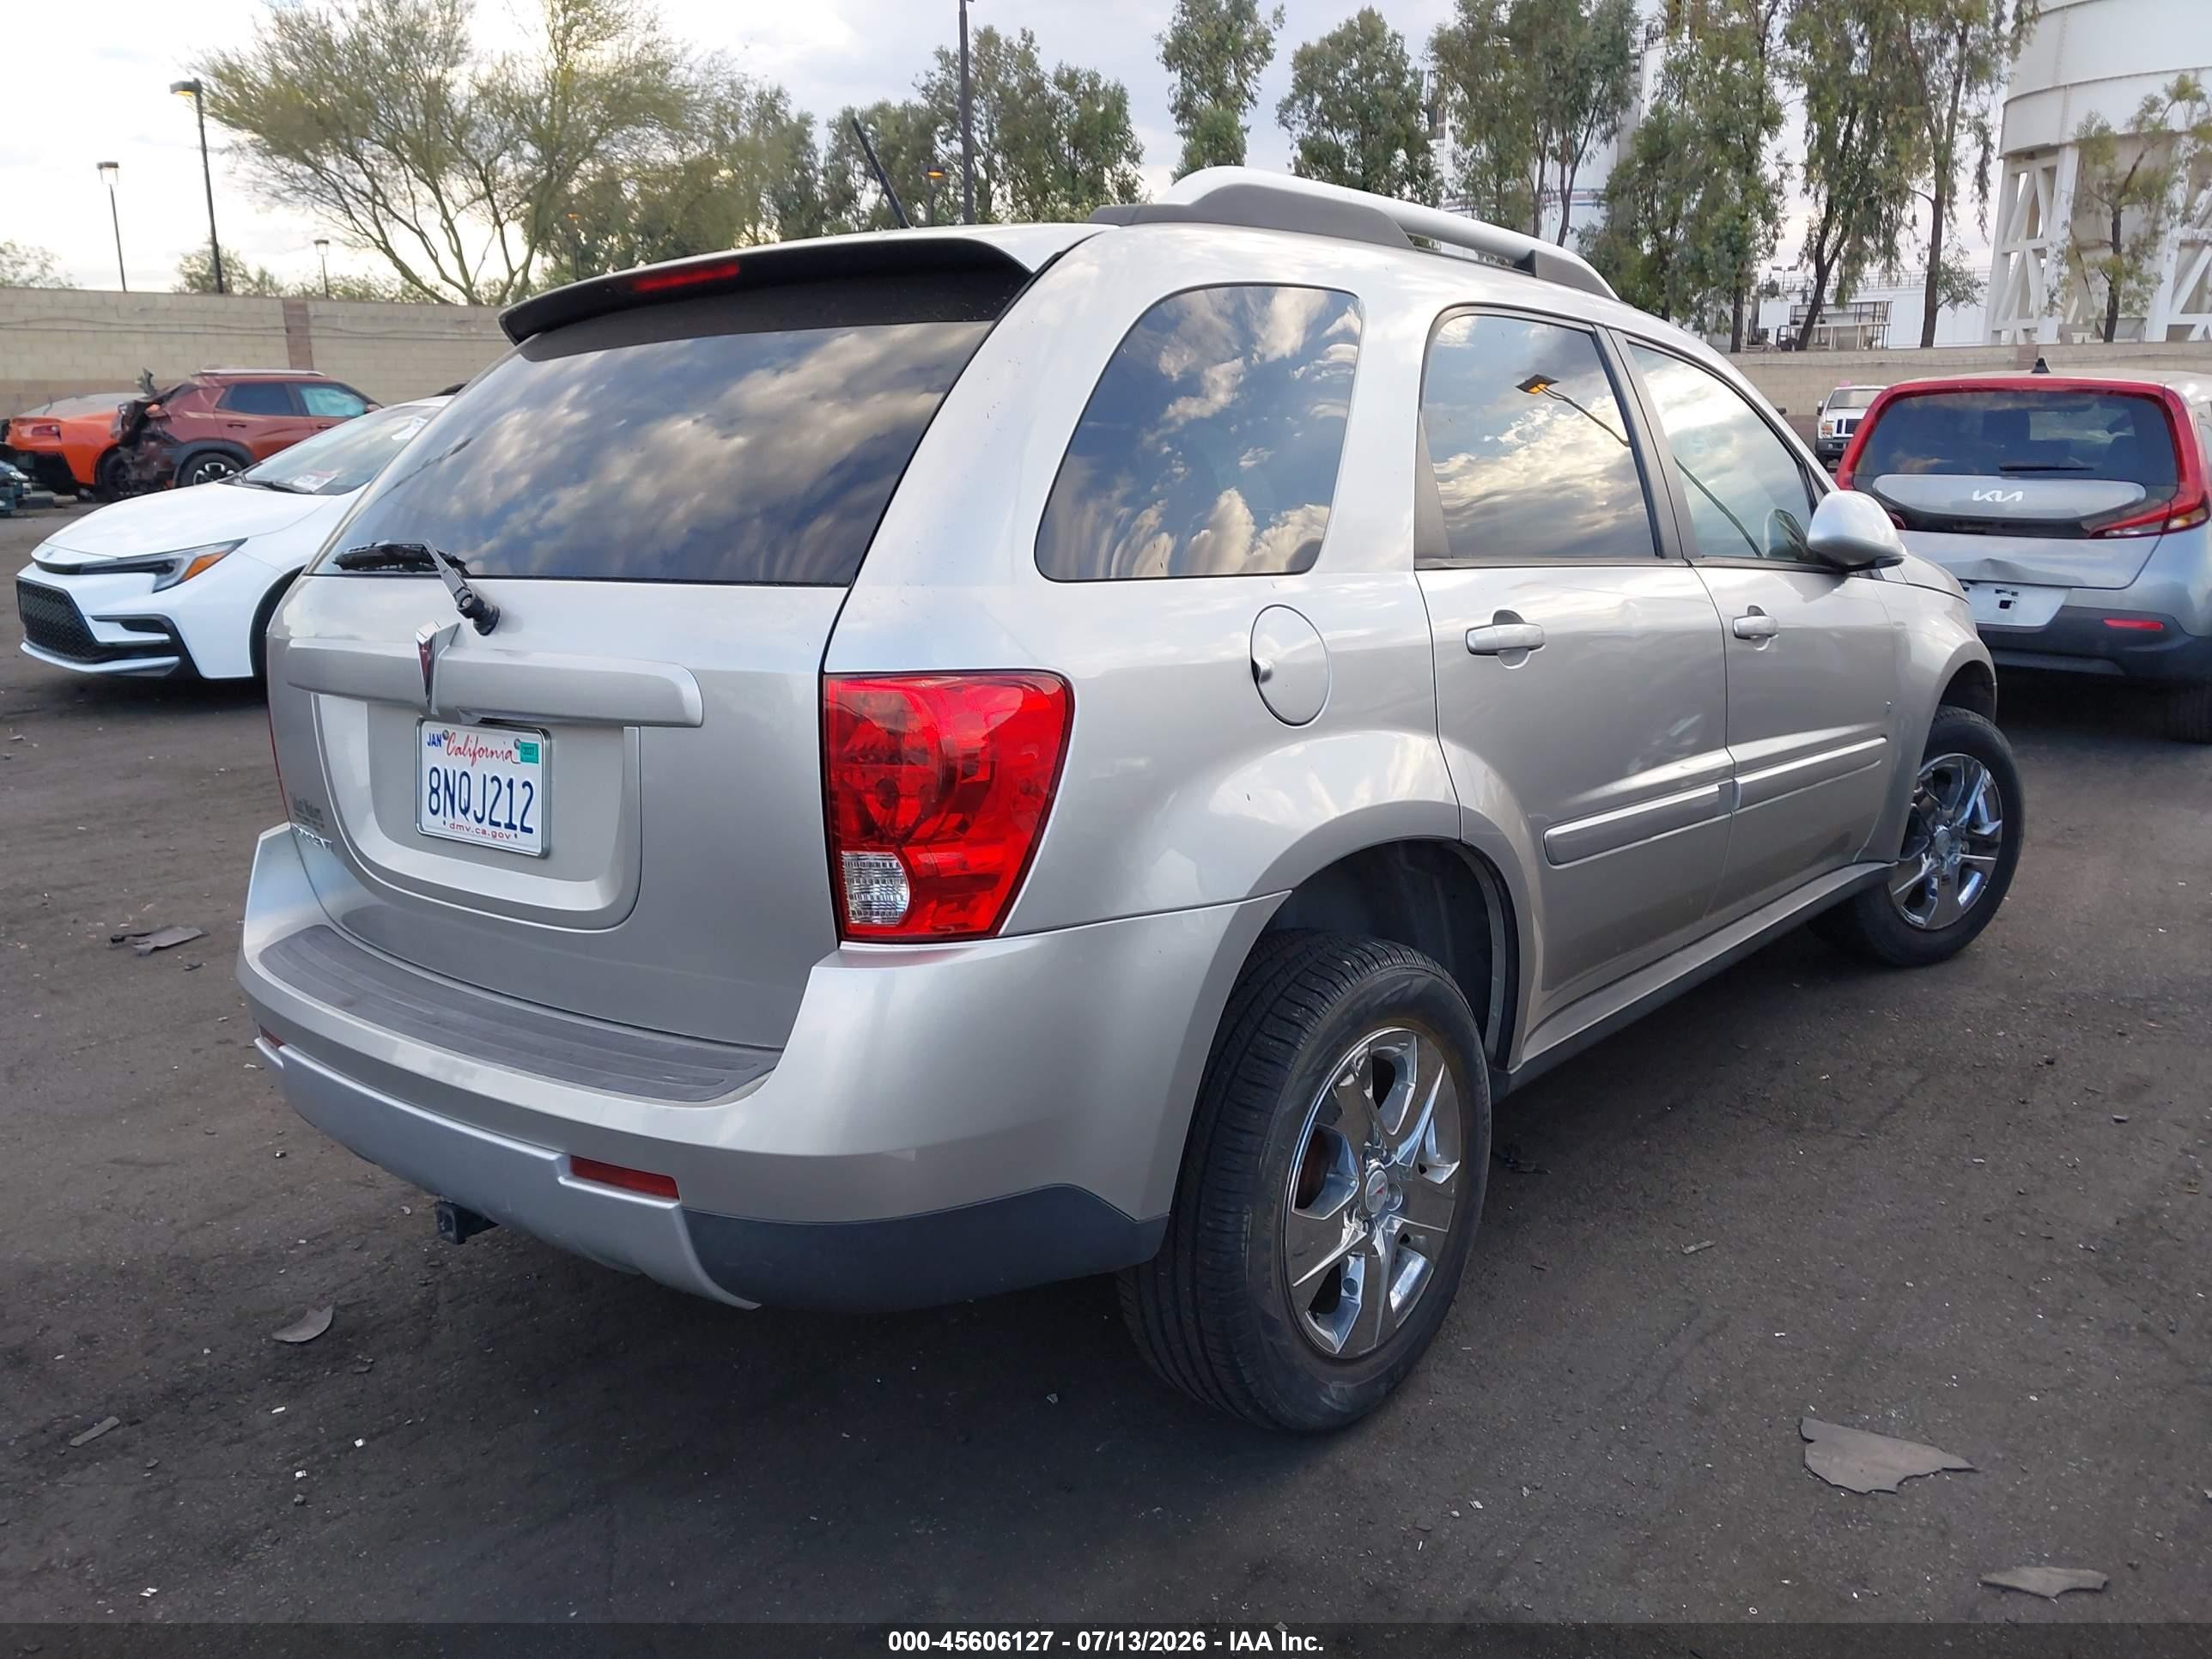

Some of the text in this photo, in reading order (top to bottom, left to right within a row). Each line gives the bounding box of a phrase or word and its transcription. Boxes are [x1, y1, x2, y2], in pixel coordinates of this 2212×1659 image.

[1972, 489, 2023, 502] KIA
[427, 732, 442, 748] JAN
[447, 732, 521, 767] California
[428, 766, 534, 835] 8NQJ212
[449, 820, 512, 840] dmv.ca.gov
